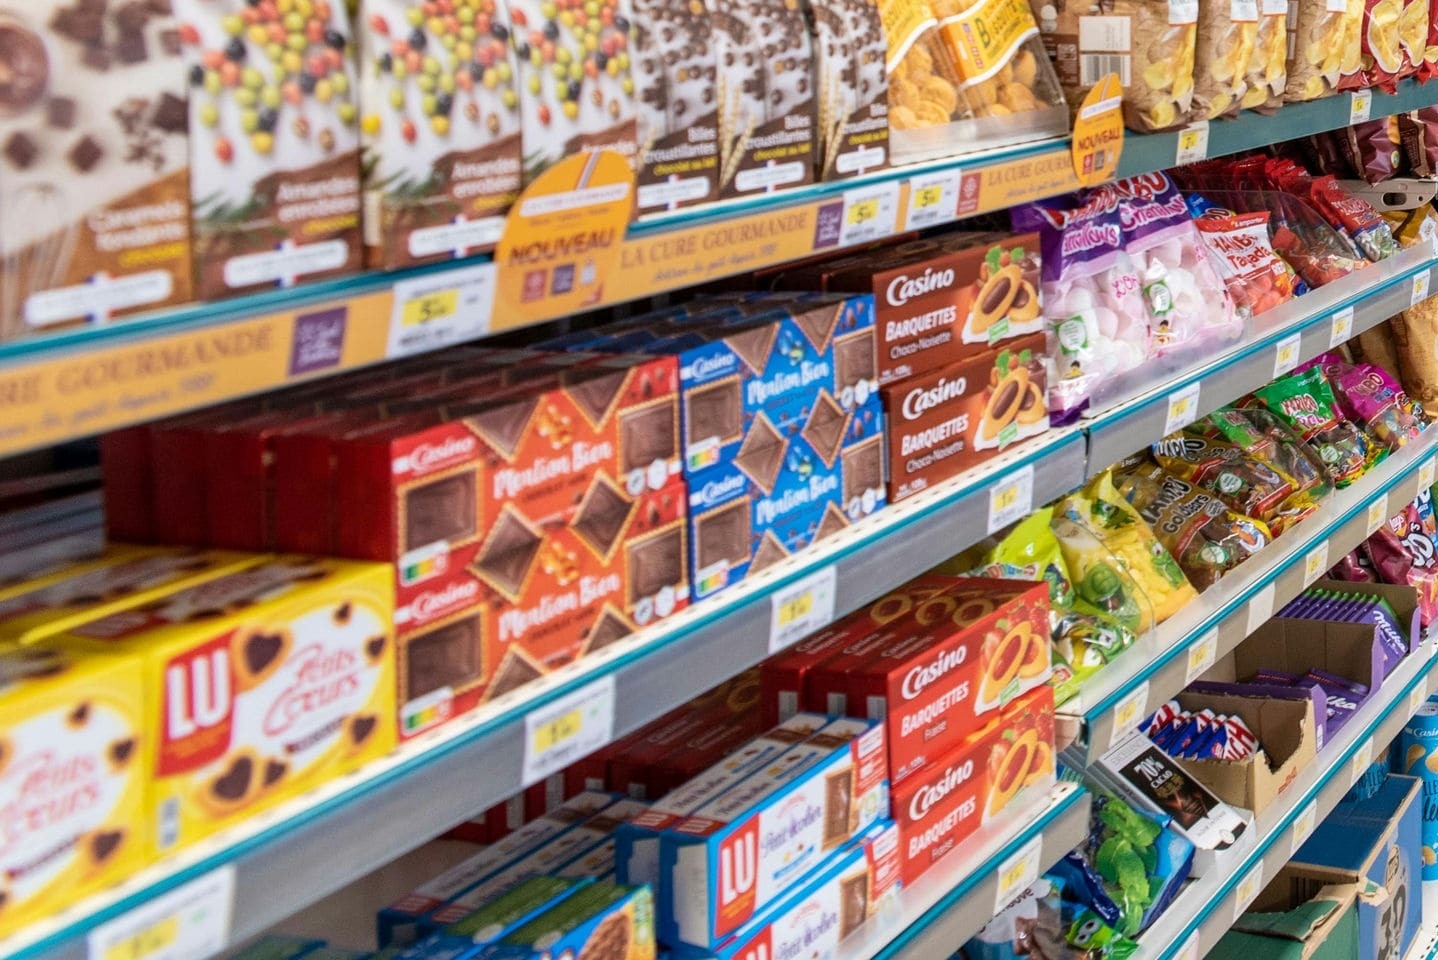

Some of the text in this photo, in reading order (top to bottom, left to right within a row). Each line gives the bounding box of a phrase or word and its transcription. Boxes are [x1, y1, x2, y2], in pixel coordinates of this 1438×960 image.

[1077, 131, 1121, 150] NOUVEAU
[509, 228, 615, 268] NOUVEAU
[703, 212, 807, 252] GOURMANDE
[1227, 246, 1272, 271] Tagada
[886, 267, 954, 307] Casino
[886, 306, 956, 342] BARQUETTES
[56, 323, 272, 391] GOURMANDE
[890, 330, 952, 360] Choco-Noisette
[801, 361, 829, 386] Bien
[902, 377, 966, 420] Casino
[901, 414, 969, 457] BARQUETTES
[573, 439, 612, 473] Bien
[906, 440, 964, 473] Choco-Noisette
[810, 475, 837, 501] Bien
[581, 573, 621, 608] Bien
[901, 645, 967, 700] Casino
[166, 646, 231, 740] LU
[901, 680, 969, 737] BARQUETTES
[1133, 756, 1165, 782] 70%
[1150, 770, 1173, 789] CACAO
[909, 760, 974, 821] Casino
[908, 796, 976, 860] BARQUETTES
[720, 829, 755, 907] LU
